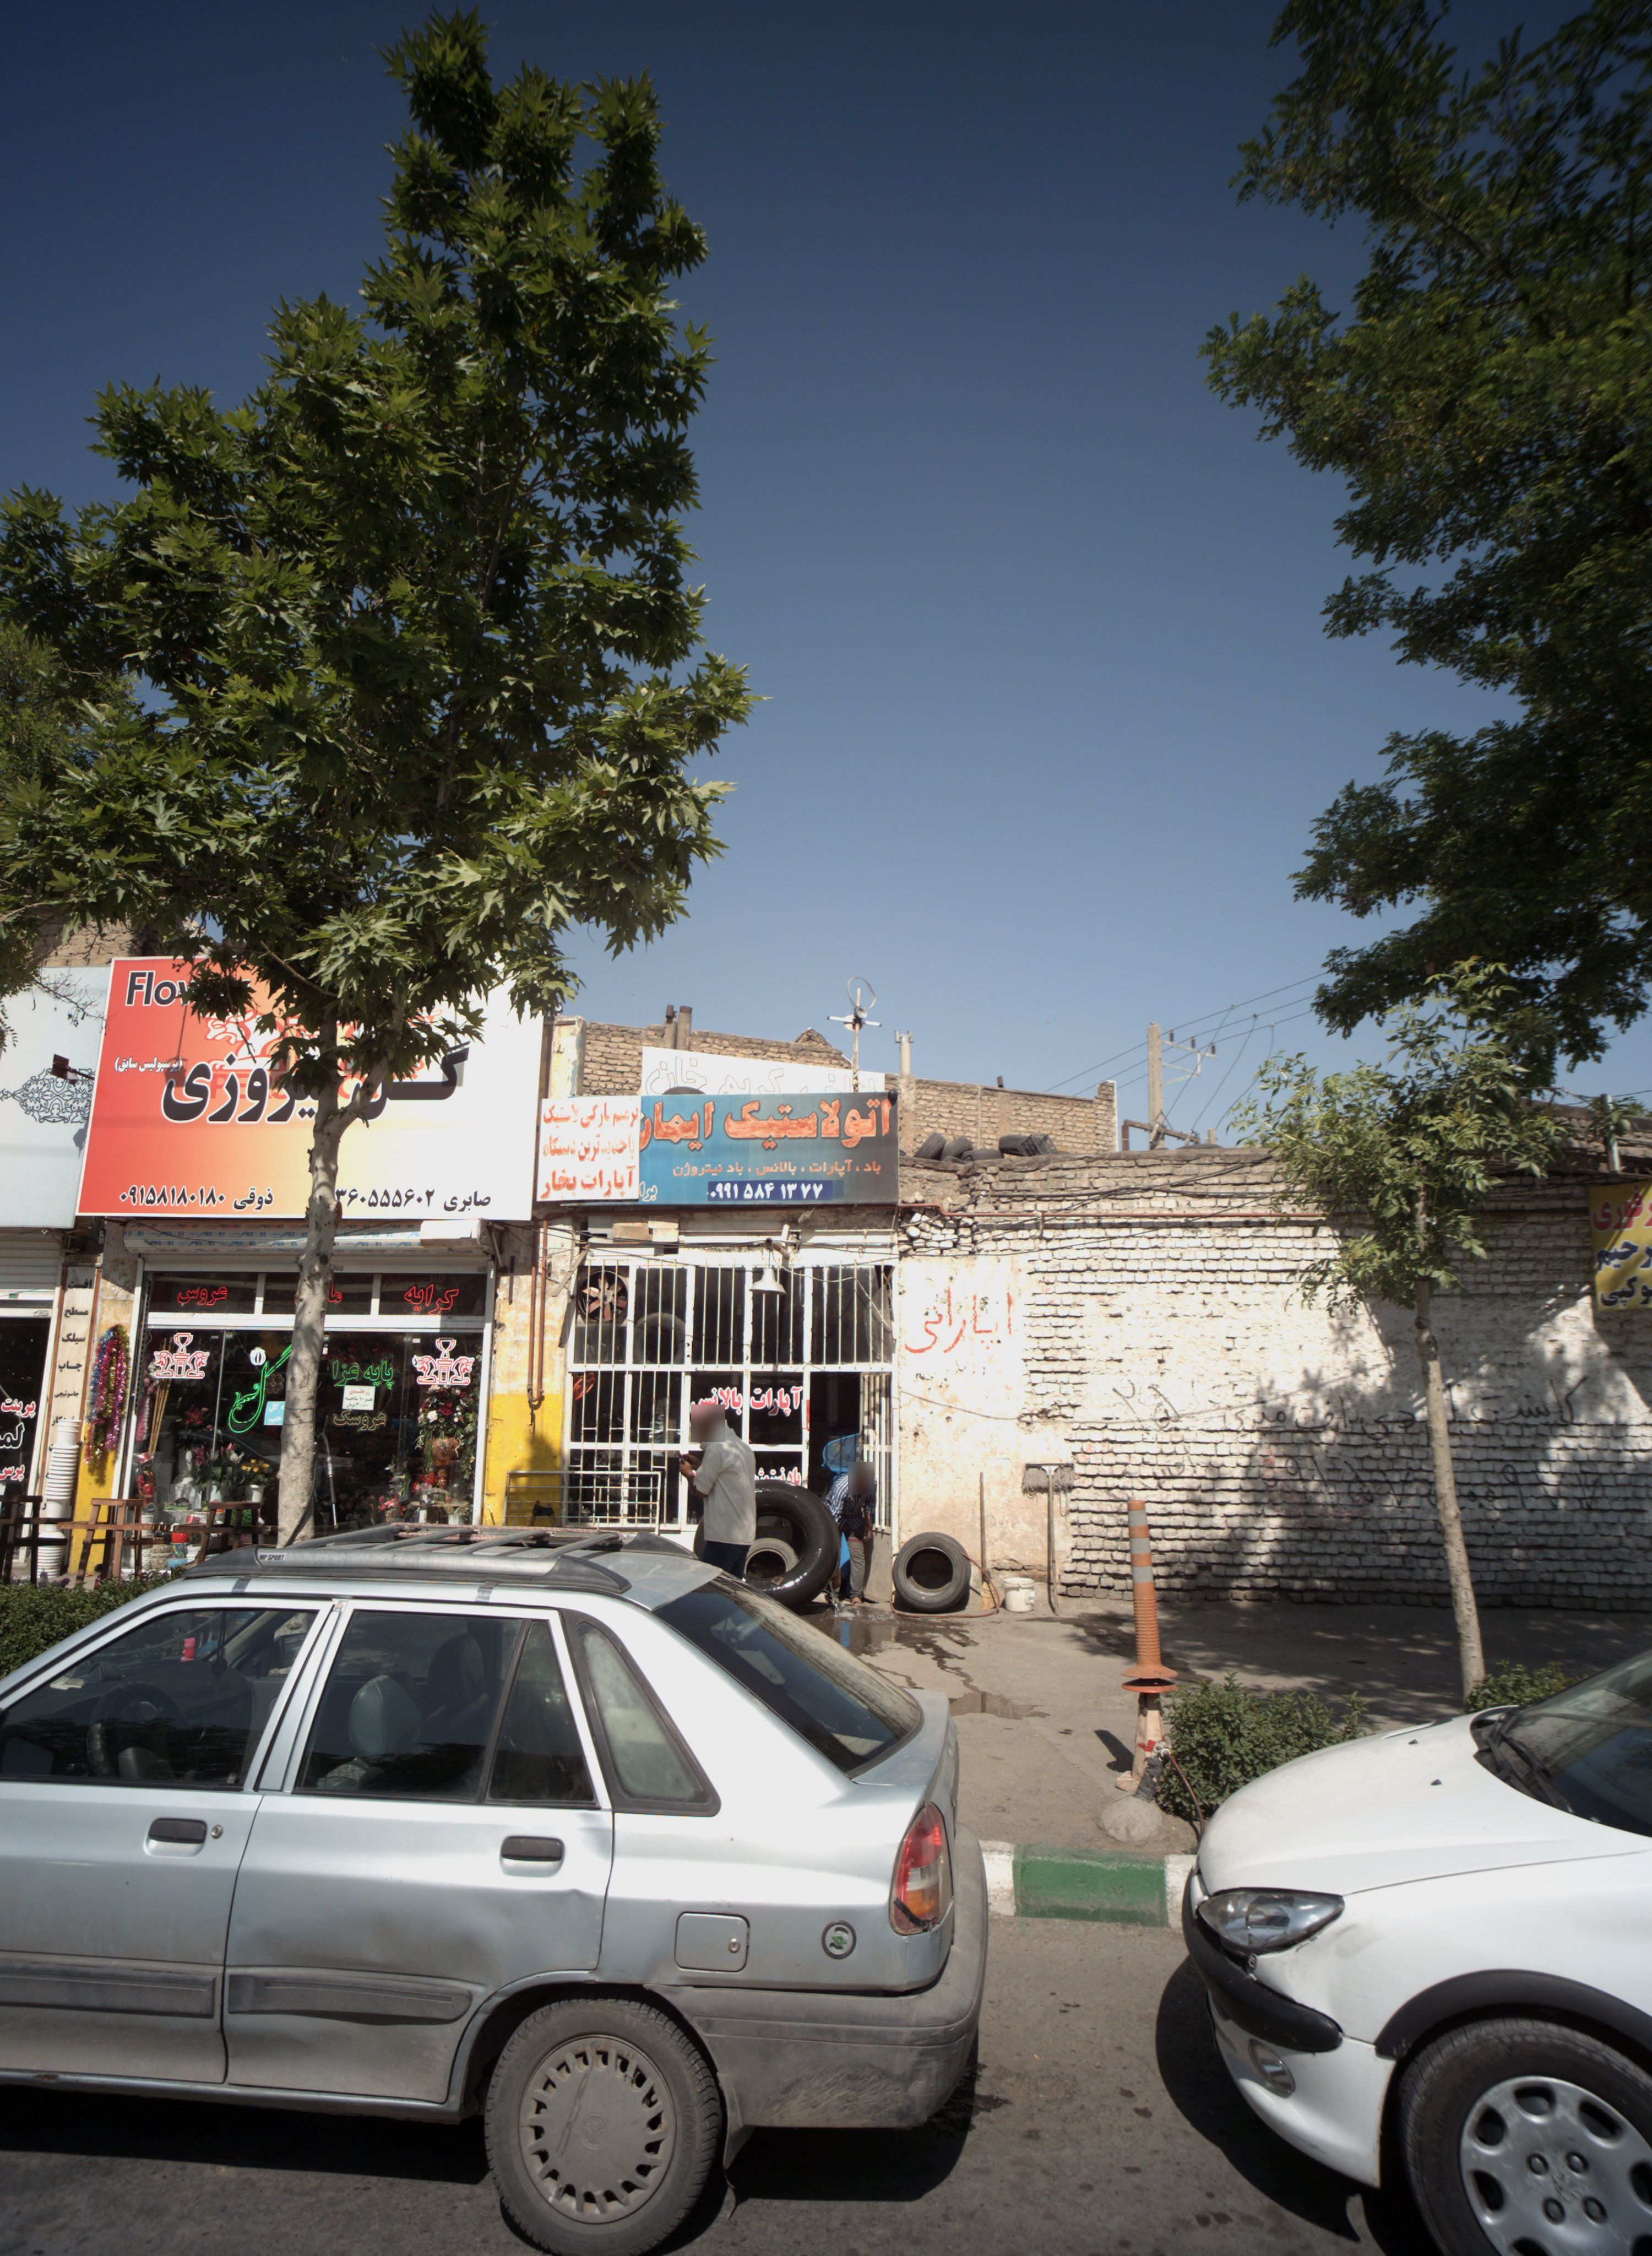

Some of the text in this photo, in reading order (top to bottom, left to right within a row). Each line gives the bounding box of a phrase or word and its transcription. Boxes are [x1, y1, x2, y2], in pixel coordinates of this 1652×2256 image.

[672, 1162, 723, 1177] نیتروژن
[726, 1161, 744, 1176] باد
[755, 1161, 797, 1176] بالانس
[808, 1159, 853, 1178] آپارات
[540, 1164, 636, 1199] آپارات بخار
[119, 1185, 226, 1206] ۰۹۱۵۸۱۸۰۱۸۰
[335, 1188, 492, 1212] صابری ۳۶۰۵۵۵۶۰۲
[68, 1279, 93, 1289] افست
[177, 1286, 228, 1306] عروس
[404, 1284, 460, 1316] کرایه
[64, 1307, 89, 1318] مسطح
[62, 1333, 86, 1344] سیلک
[58, 1360, 83, 1372] چاپ
[332, 1359, 395, 1389] پایه عزا
[1, 1398, 36, 1418] پرینت
[749, 1386, 803, 1417] آپارات
[333, 1410, 388, 1431] عروسک
